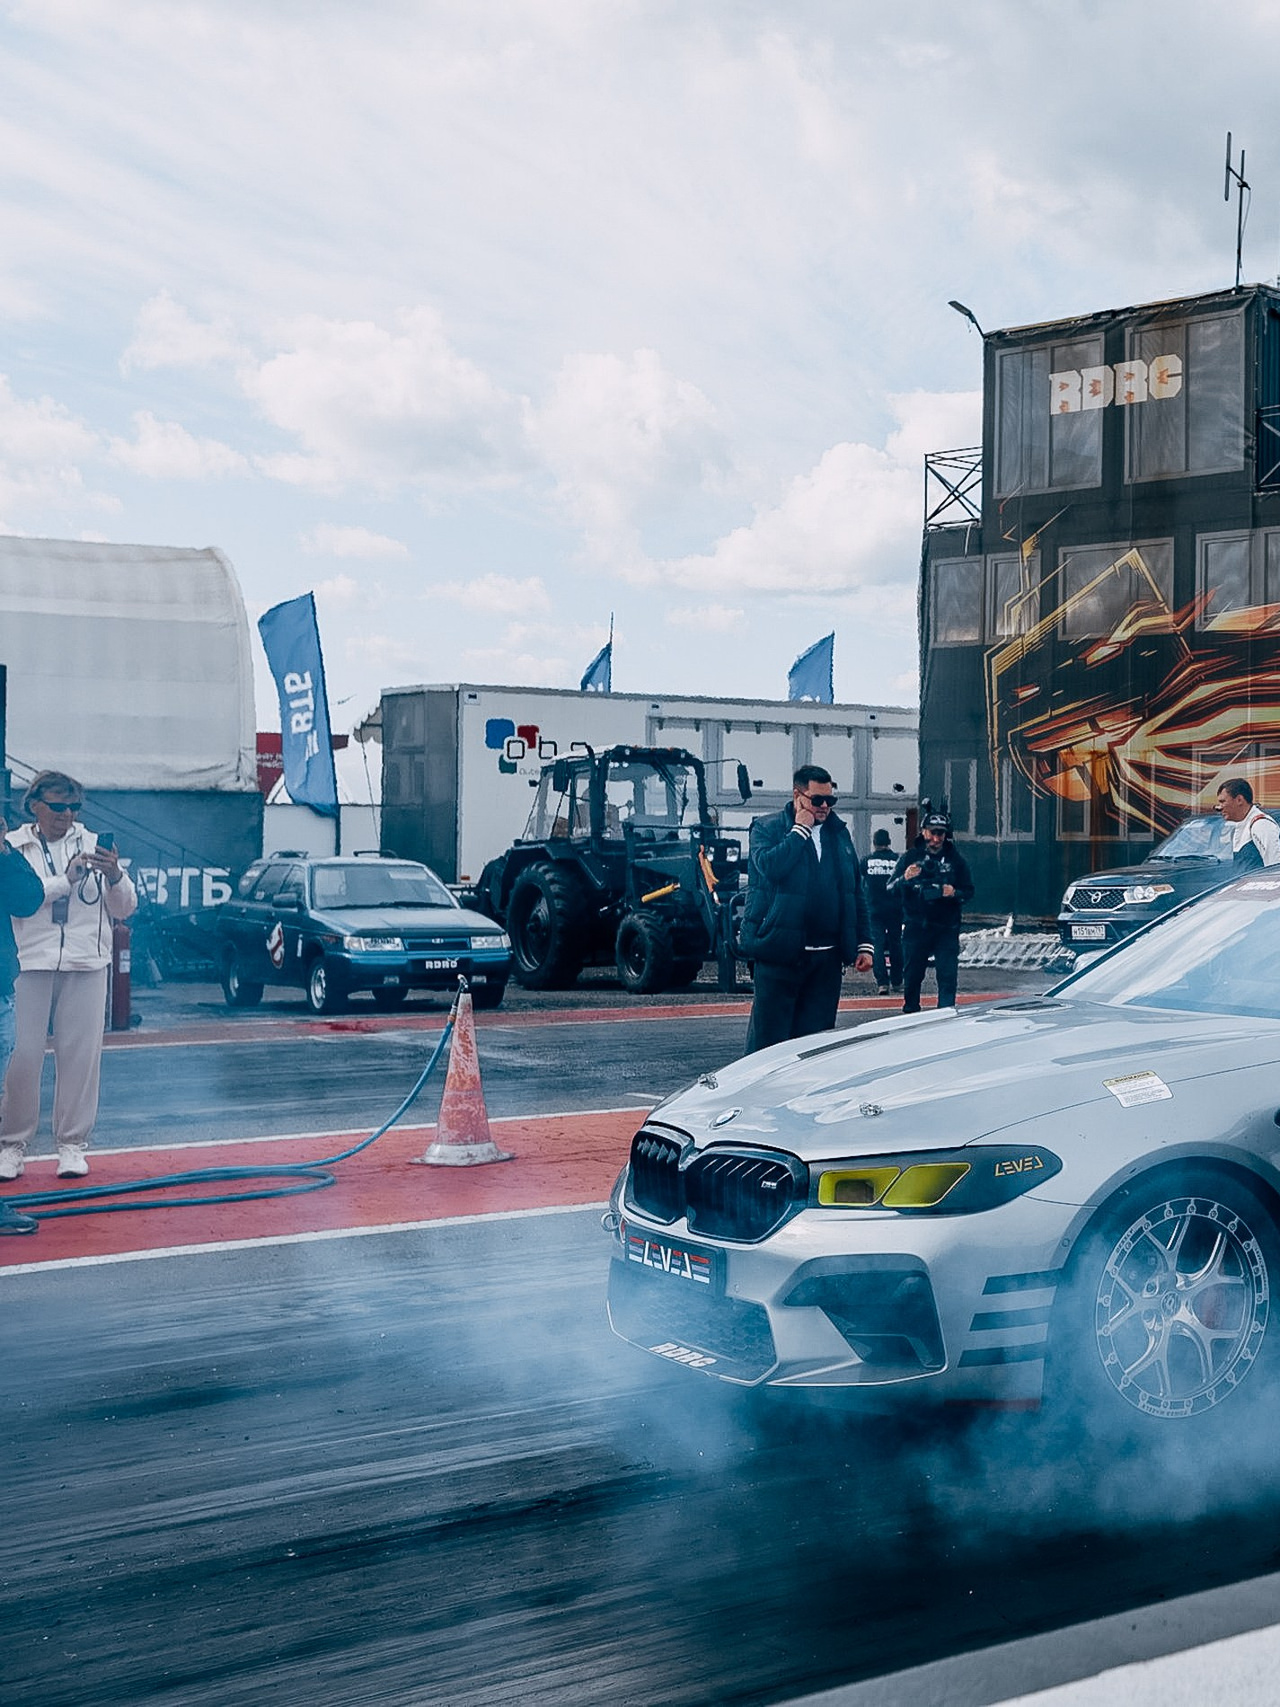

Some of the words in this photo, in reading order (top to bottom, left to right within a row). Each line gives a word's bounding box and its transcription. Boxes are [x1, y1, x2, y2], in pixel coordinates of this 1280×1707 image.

[1048, 354, 1183, 416] RDRC
[137, 866, 233, 907] ВТБ
[994, 1155, 1044, 1177] LEVEL
